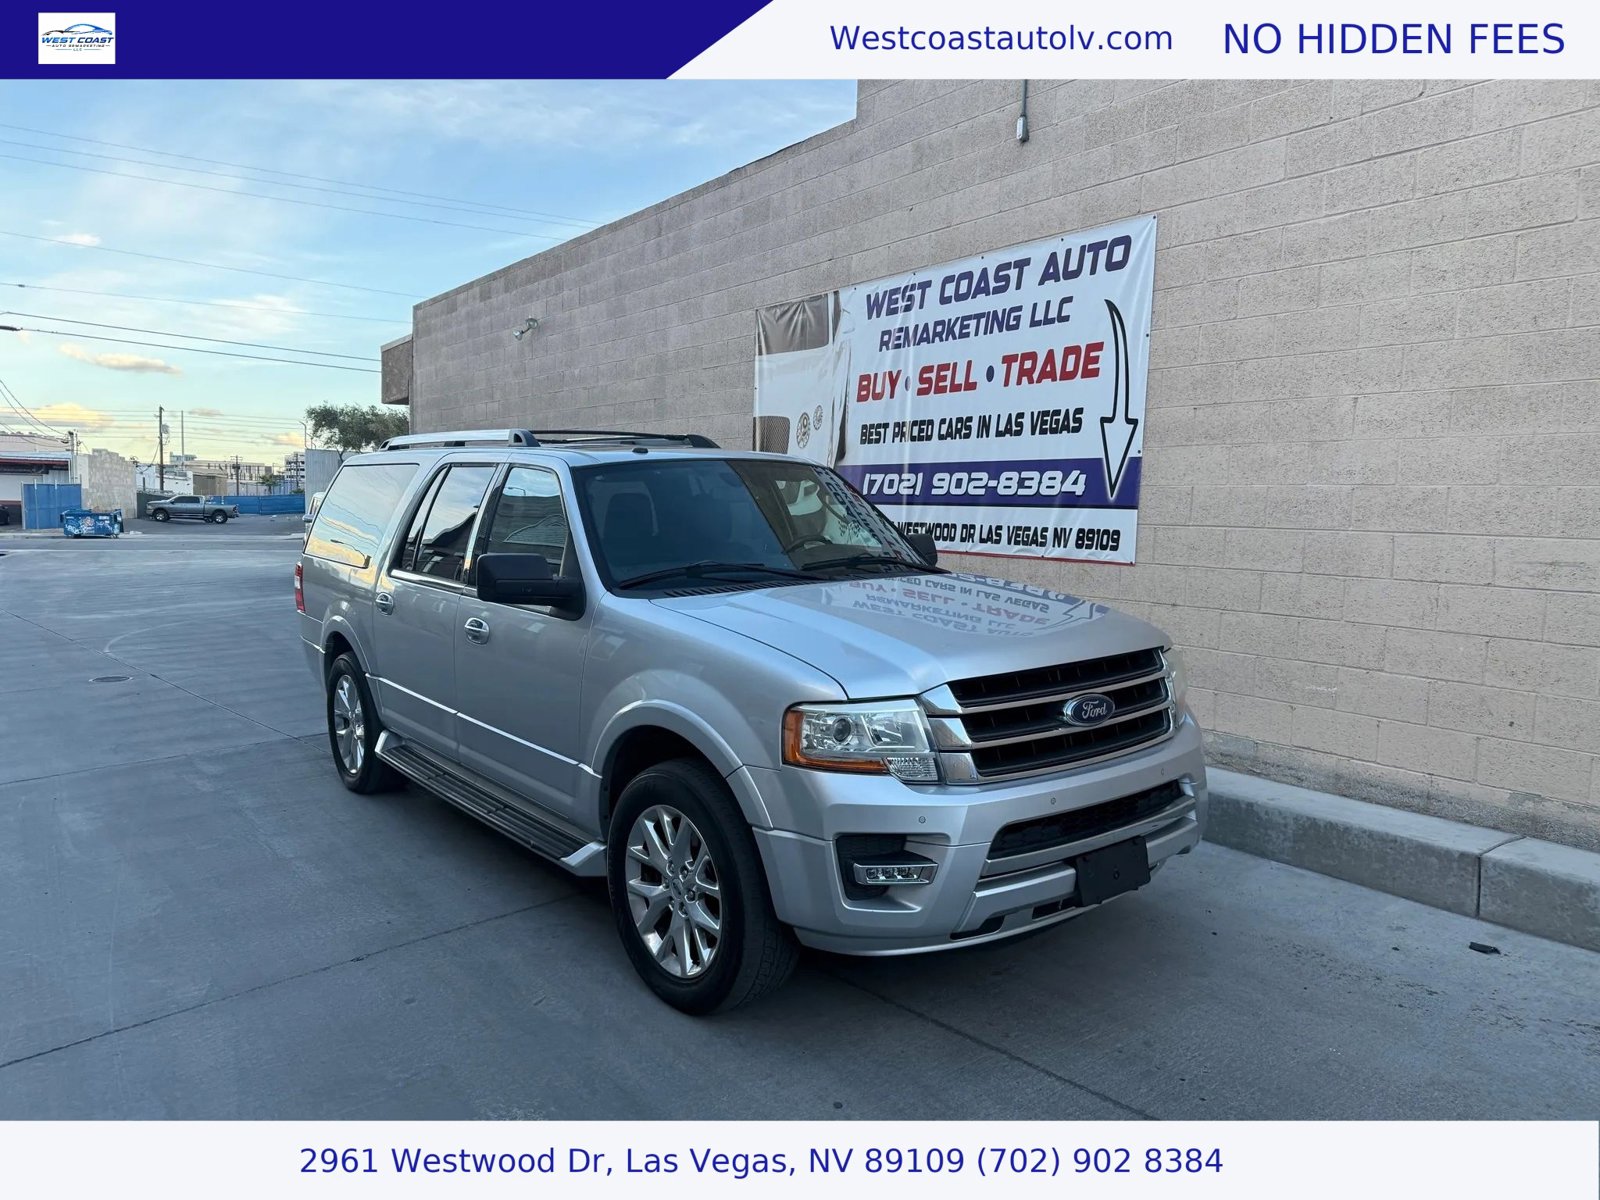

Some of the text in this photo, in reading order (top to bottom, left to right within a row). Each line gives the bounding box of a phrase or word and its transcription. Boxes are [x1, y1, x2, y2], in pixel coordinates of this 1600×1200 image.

[866, 234, 1133, 320] WEST COAST AUTO
[878, 296, 1075, 352] REMARKETING LLC
[856, 341, 1105, 402] BUY SELL TRADE
[860, 407, 1085, 445] BEST PRICED CARS IN LAS VEGAS
[931, 470, 1087, 496] 902-8384
[959, 524, 976, 543] DR
[979, 524, 1003, 545] LAS
[1006, 525, 1049, 548] VEGAS
[1052, 527, 1073, 549] NV
[1075, 528, 1121, 551] 89109
[1081, 699, 1108, 721] Ford
